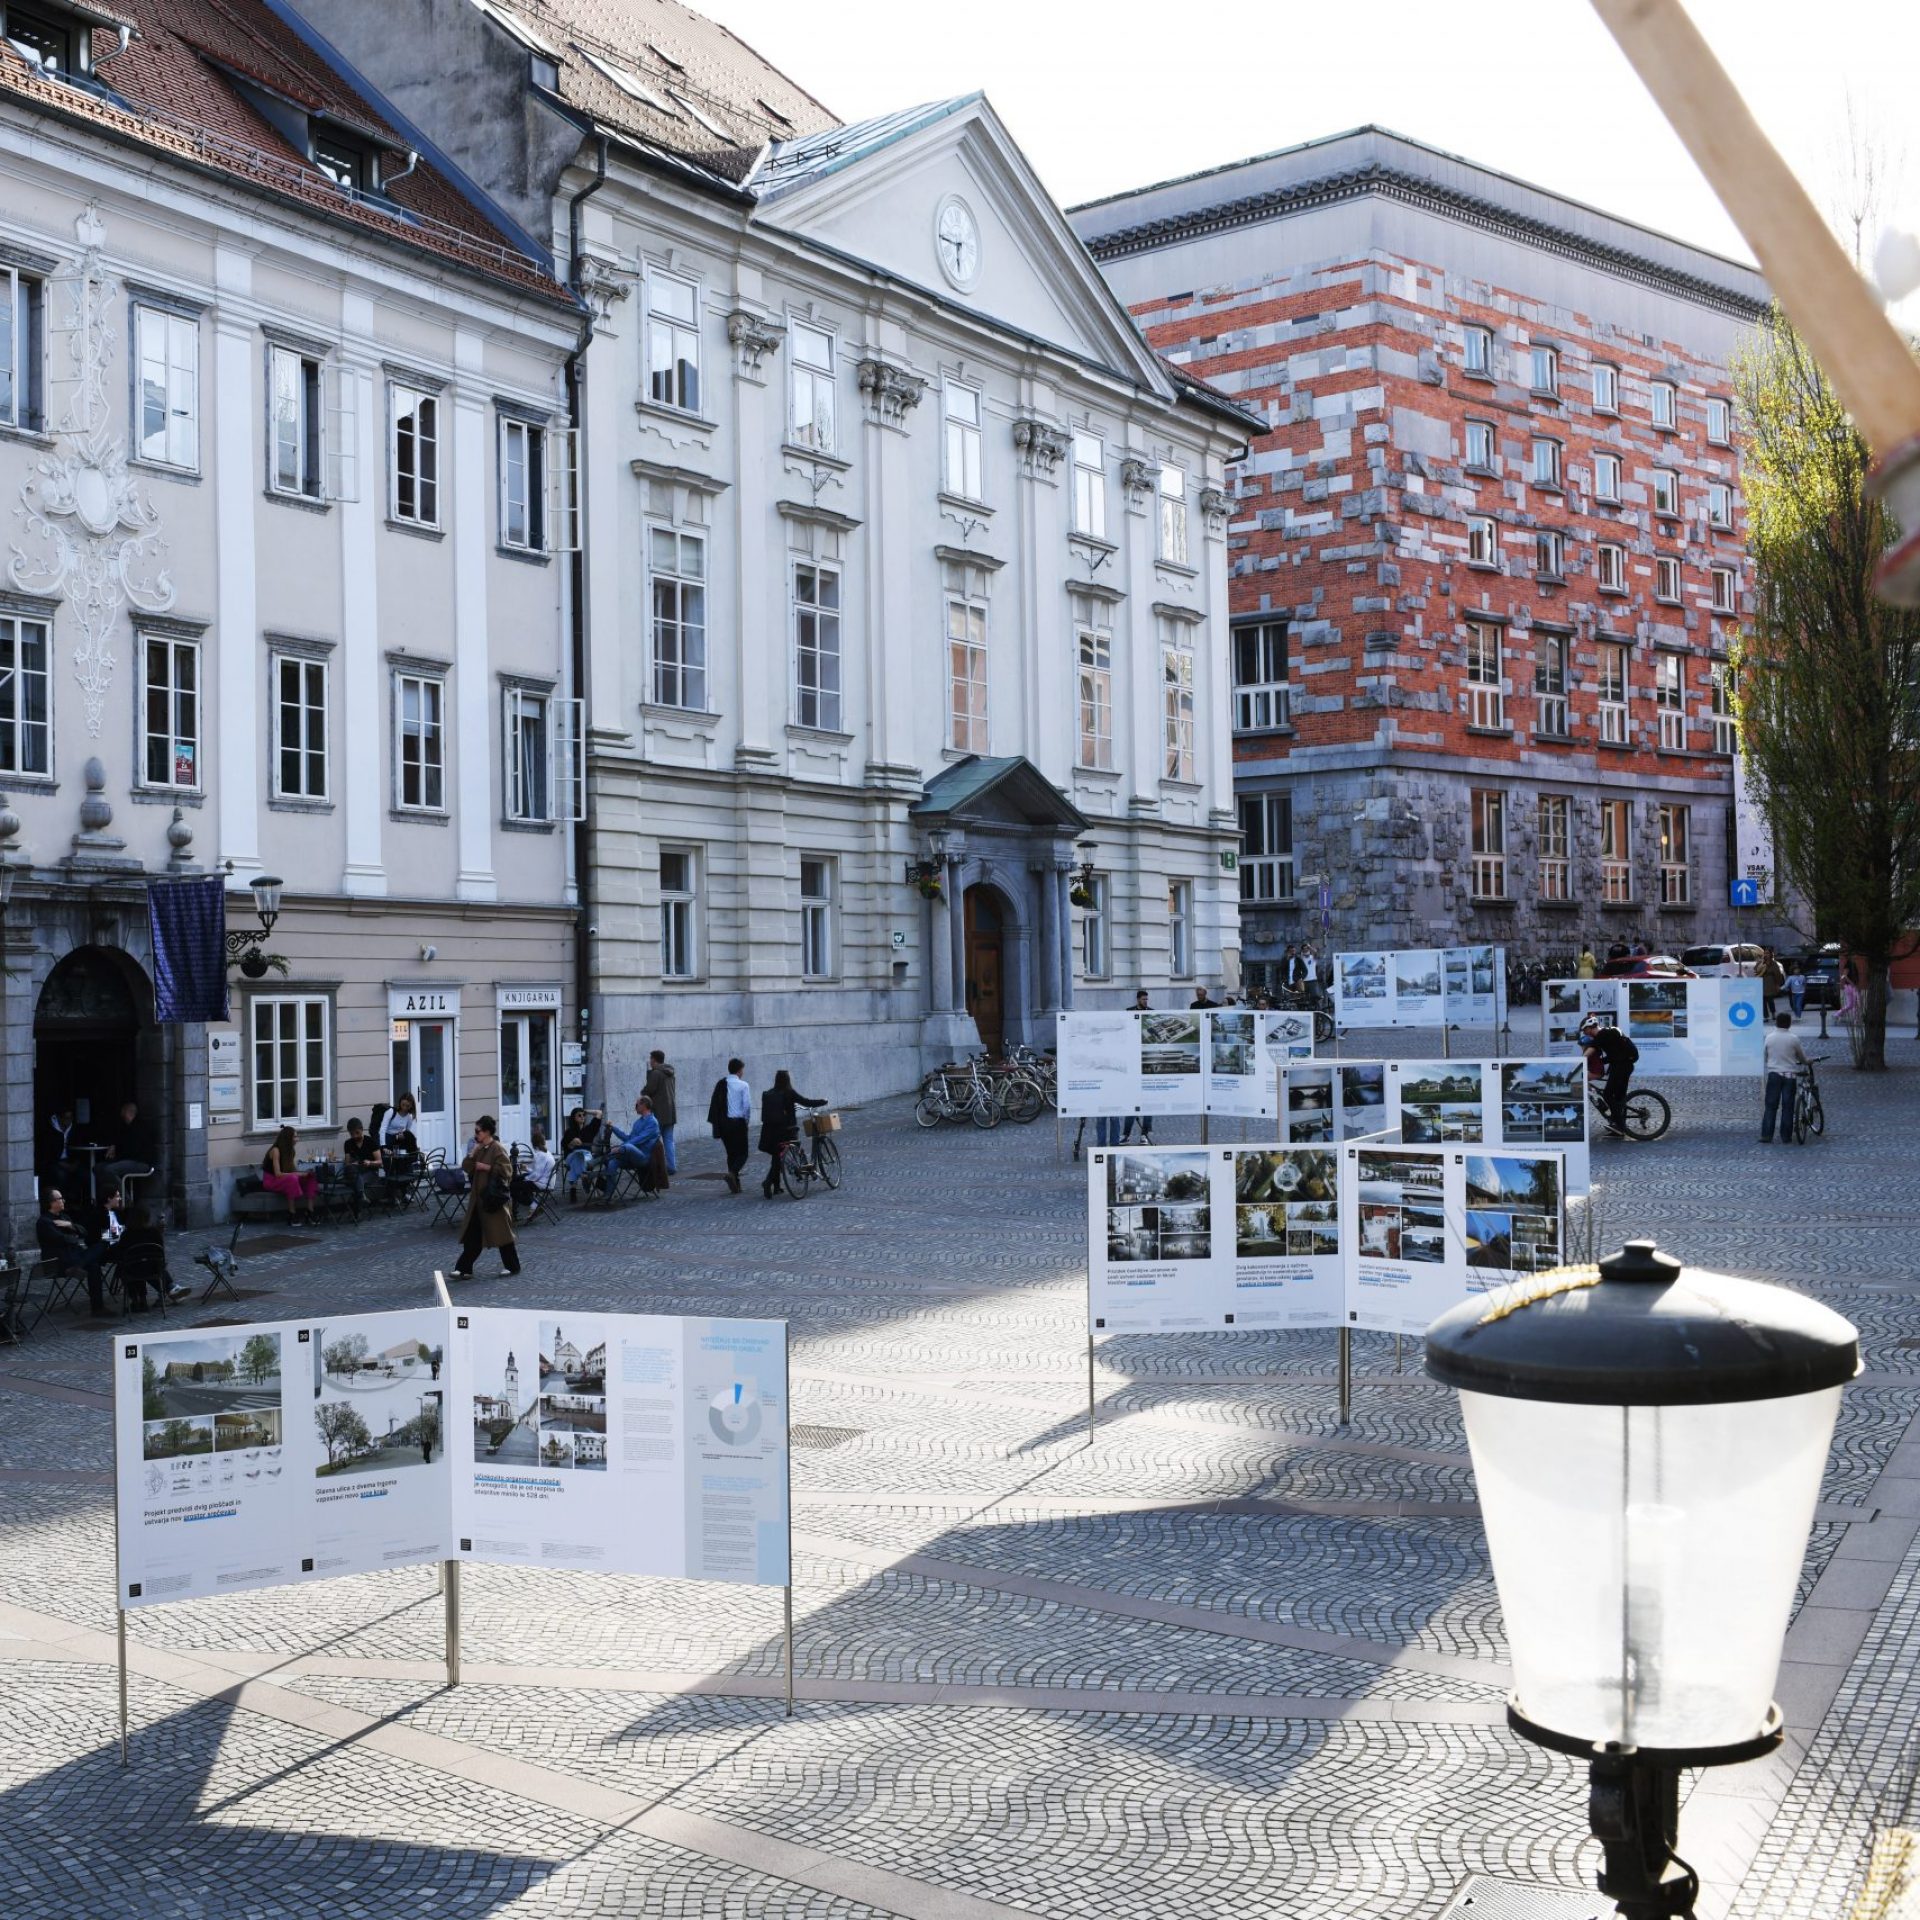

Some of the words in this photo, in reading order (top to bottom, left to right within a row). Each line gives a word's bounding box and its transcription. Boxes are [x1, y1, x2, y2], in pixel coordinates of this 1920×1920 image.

[406, 995, 446, 1010] AZIL
[504, 992, 556, 1003] KNJIGARNA
[356, 1482, 376, 1490] dvema
[144, 1508, 166, 1517] Projekt
[193, 1503, 208, 1512] dvig
[144, 1516, 170, 1526] ustvarja
